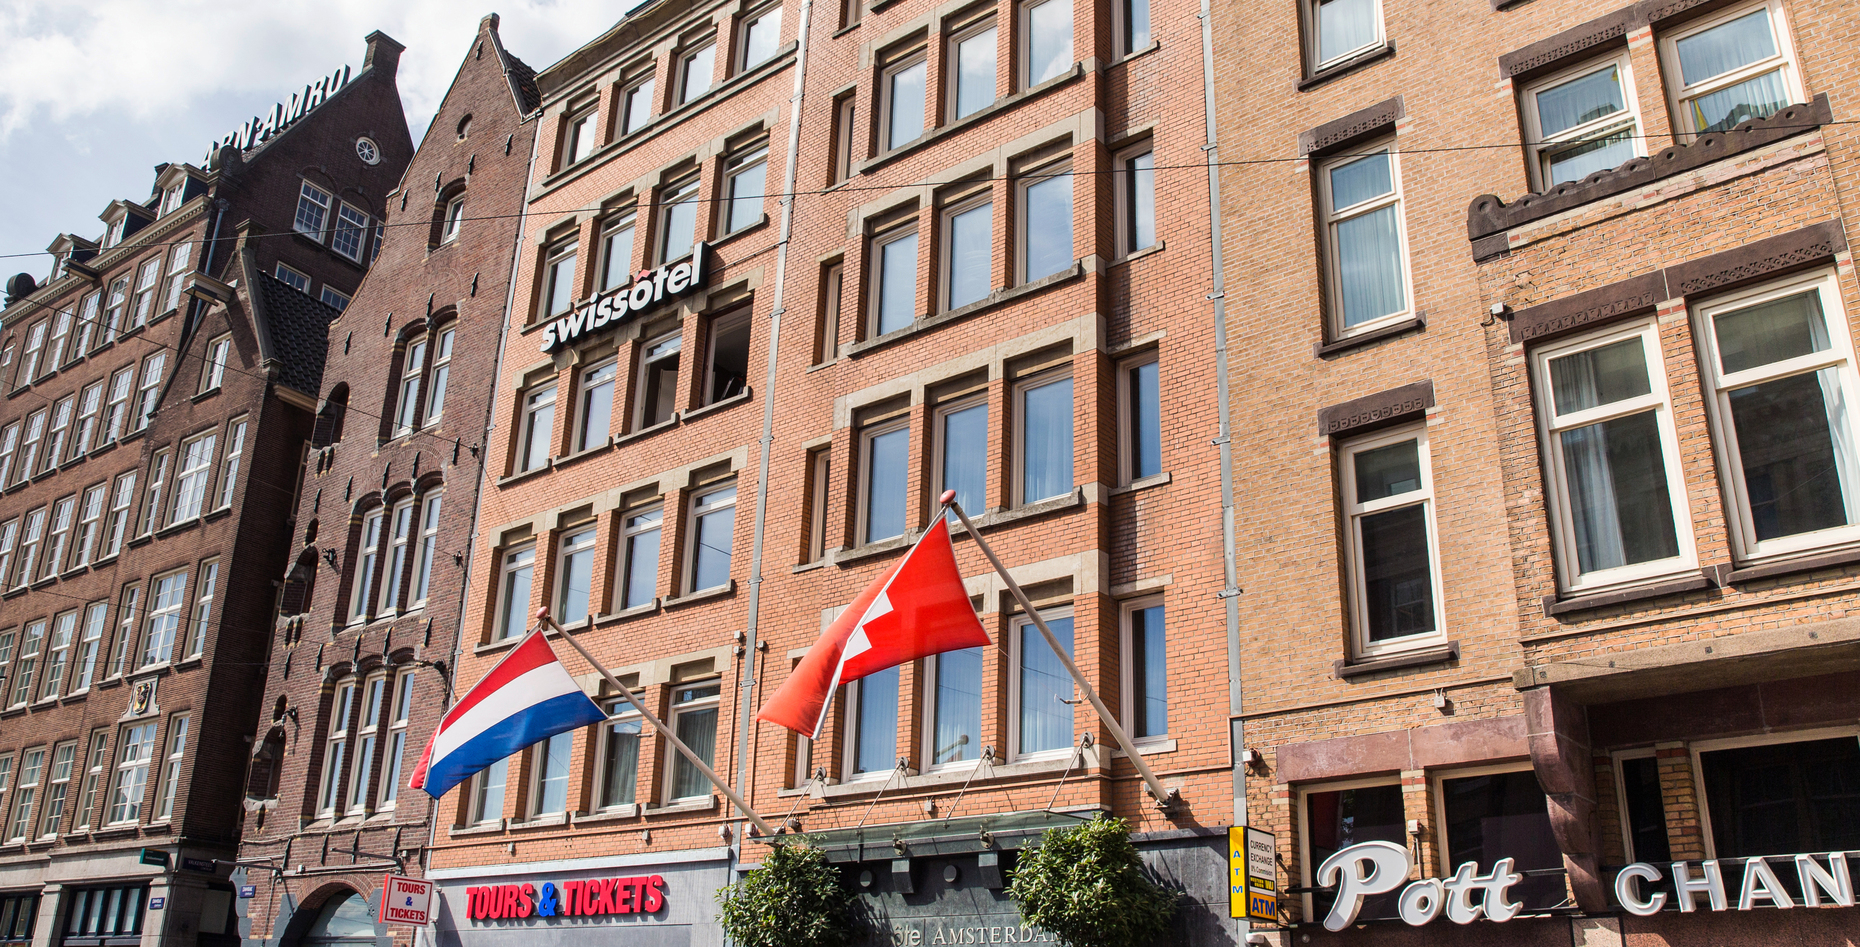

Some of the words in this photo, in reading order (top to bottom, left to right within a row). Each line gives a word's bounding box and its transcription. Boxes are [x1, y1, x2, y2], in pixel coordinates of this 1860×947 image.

[540, 241, 705, 352] swissôtel
[1250, 840, 1272, 853] CURRENCY
[1250, 853, 1273, 866] EXCHANGE
[1233, 850, 1243, 894] ATM
[396, 881, 426, 895] TOURS
[1317, 840, 1524, 932] Pott
[1615, 851, 1855, 917] CHAN
[405, 896, 413, 907] &
[466, 883, 535, 920] TOURS
[538, 882, 558, 917] &
[563, 874, 664, 916] TICKETS
[1252, 897, 1275, 917] ATM
[389, 907, 425, 921] TICKETS
